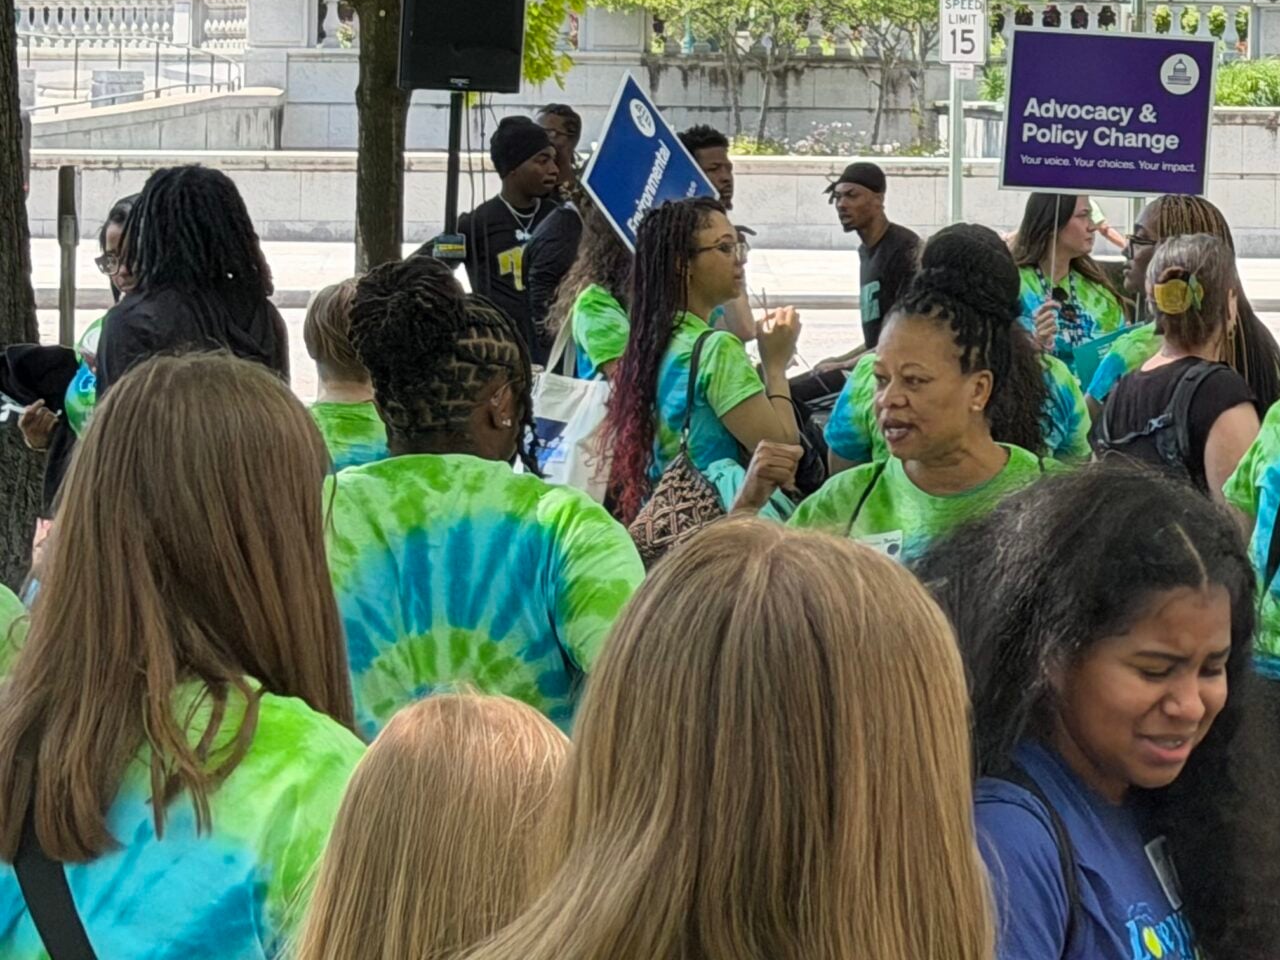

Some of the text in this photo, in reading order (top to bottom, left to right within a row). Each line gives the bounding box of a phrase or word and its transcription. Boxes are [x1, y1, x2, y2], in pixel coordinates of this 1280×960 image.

[948, 13, 977, 25] LIMIT
[950, 28, 975, 55] 15
[1023, 97, 1157, 126] Advocacy &
[1022, 123, 1180, 154] Policy Change
[1020, 154, 1197, 173] Your voice. Your choices. Your impact.
